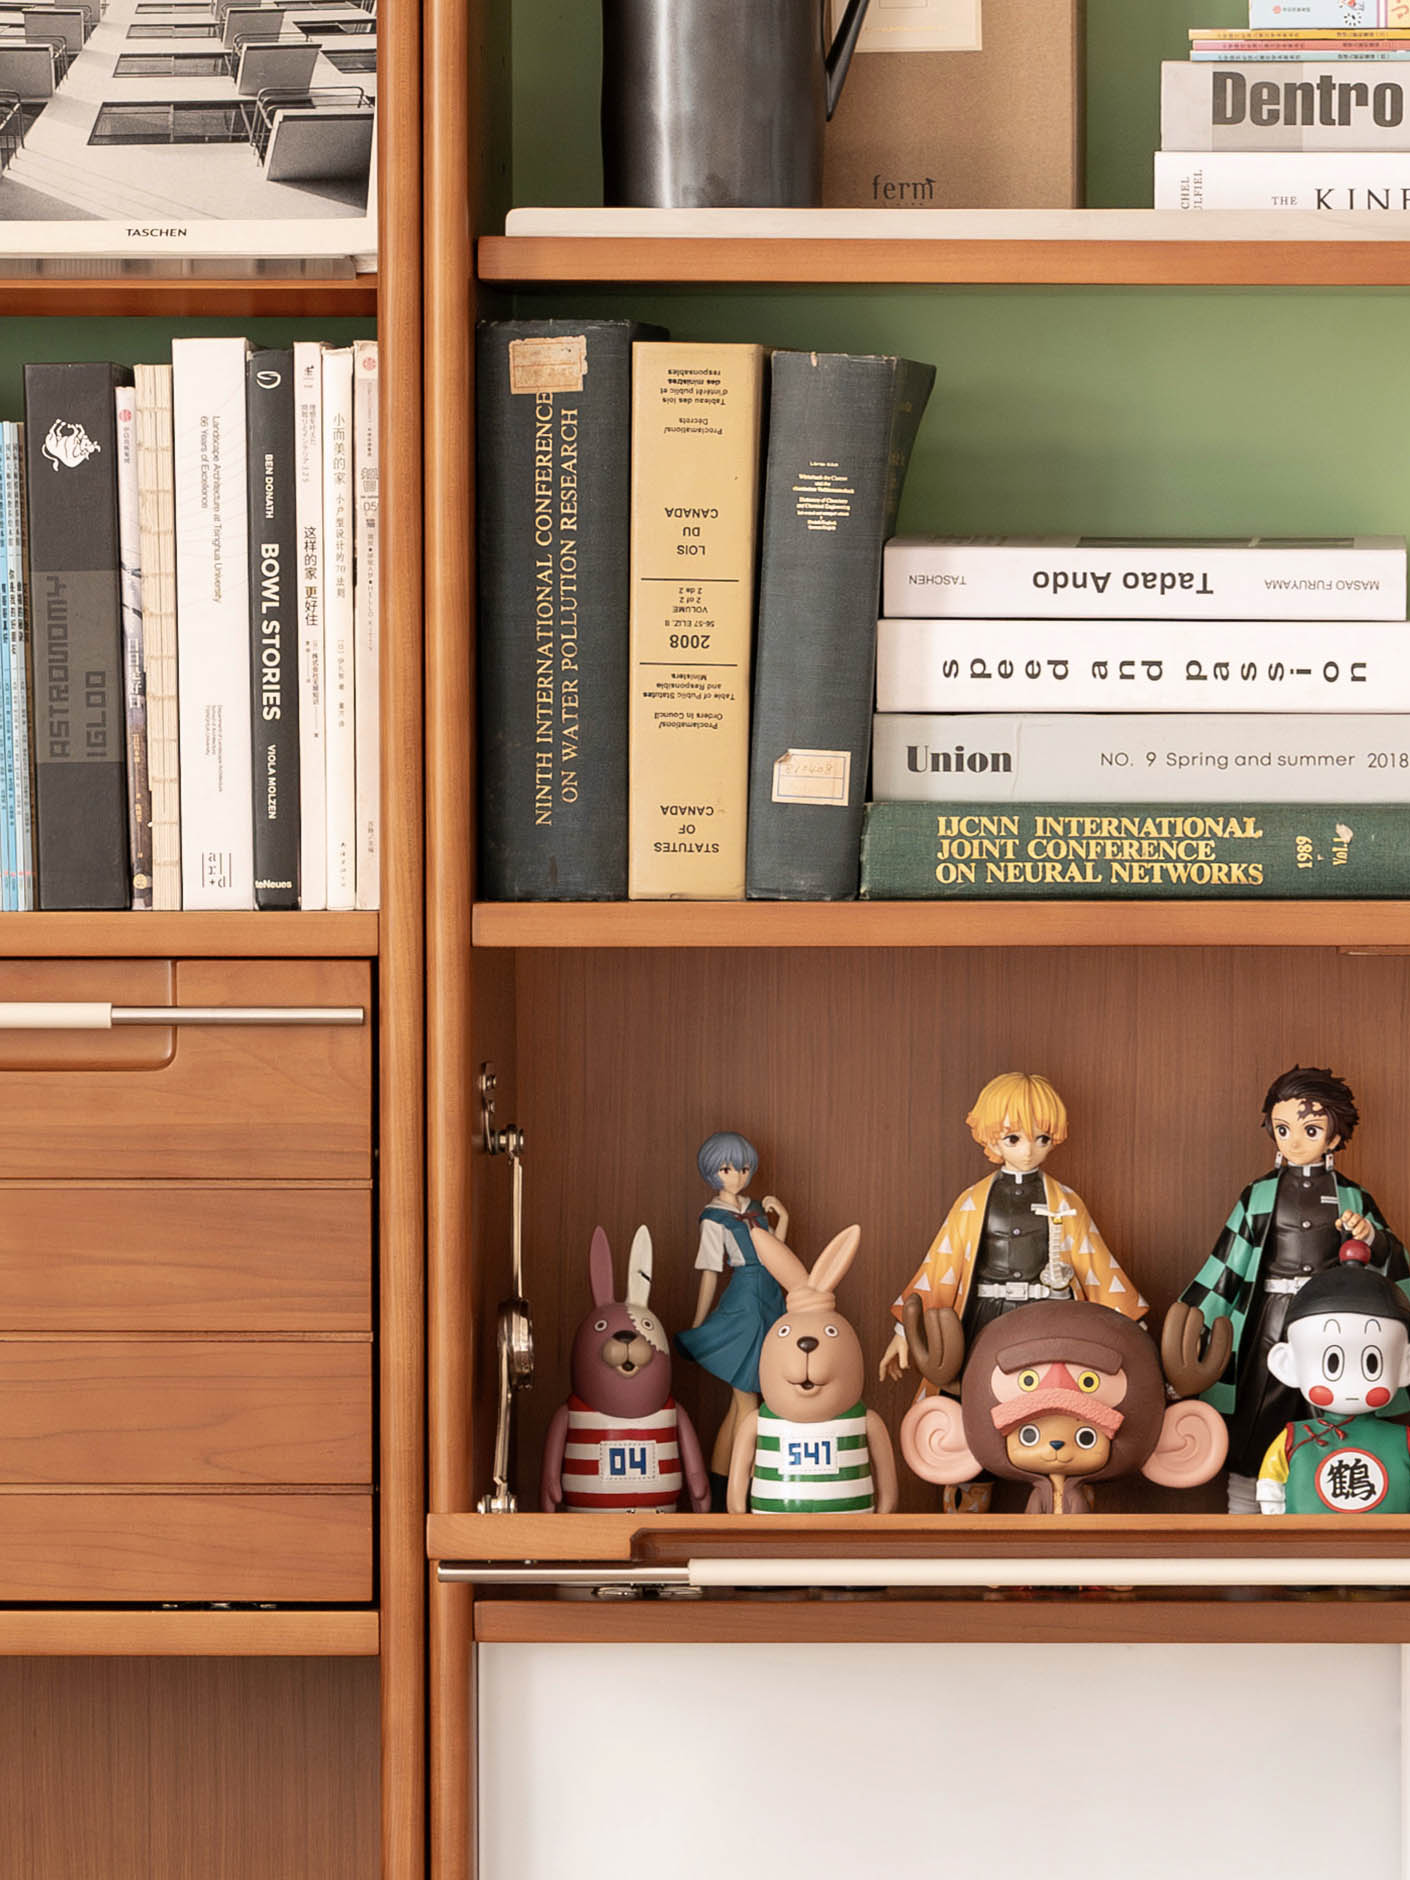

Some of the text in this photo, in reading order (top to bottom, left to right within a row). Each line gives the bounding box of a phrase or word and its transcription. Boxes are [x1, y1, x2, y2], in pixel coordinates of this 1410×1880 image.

[1212, 71, 1404, 128] Dentro
[872, 174, 936, 201] ferm
[1271, 196, 1298, 206] THE
[126, 227, 188, 238] TASCHEN
[694, 397, 726, 406] Tableau
[200, 429, 209, 452] Years
[333, 414, 346, 485] 小而美的家
[200, 454, 208, 462] of
[265, 454, 274, 518] BEN DONATH
[212, 415, 224, 603] Landscape Architecture at Tsinghua University
[664, 507, 719, 519] CANADA
[682, 526, 701, 537] DU
[304, 526, 317, 581] 这样的家
[676, 544, 706, 555] LOIS
[908, 575, 967, 585] TASCHEN
[1032, 570, 1214, 595] Tadao Ando
[1264, 579, 1380, 591] MASAO FURUYAMA
[678, 587, 685, 595] 2
[679, 596, 702, 604] 2 of 2
[696, 587, 703, 595] 2
[305, 586, 320, 626] 更好住
[535, 392, 554, 826] NINTH INTERNATIONAL CONFERENCE
[560, 408, 579, 804] ON WATER POLLUTION RESEARCH
[672, 605, 708, 614] VOLUME
[261, 543, 281, 721] BOWL STORIES
[669, 634, 711, 648] 2008
[48, 575, 70, 758] ASTRONOMY
[943, 658, 1367, 683] speed and passion
[656, 681, 722, 690] and Responsible
[670, 672, 707, 681] Ministers
[643, 691, 735, 700] Table of Public Statutes
[86, 670, 107, 757] IGLOO
[696, 711, 723, 720] Orders
[658, 720, 719, 730] Proclamations/
[907, 745, 1410, 774] Union NO. 9 Spring and summer 2018
[267, 744, 277, 819] VIOLA MOLZEN
[659, 805, 714, 816] CANADA
[678, 823, 696, 835] OF
[937, 816, 1263, 838] IJCNN INTERNATIONAL
[654, 842, 720, 853] STATUTES
[936, 839, 1216, 861] JOINT CONFERENCE
[1296, 835, 1313, 868] 1989
[935, 862, 1264, 886] ON NEURAL NETWORKS
[255, 879, 292, 889] teNeues
[610, 1445, 648, 1476] 04
[1328, 1457, 1377, 1502] 鶴
